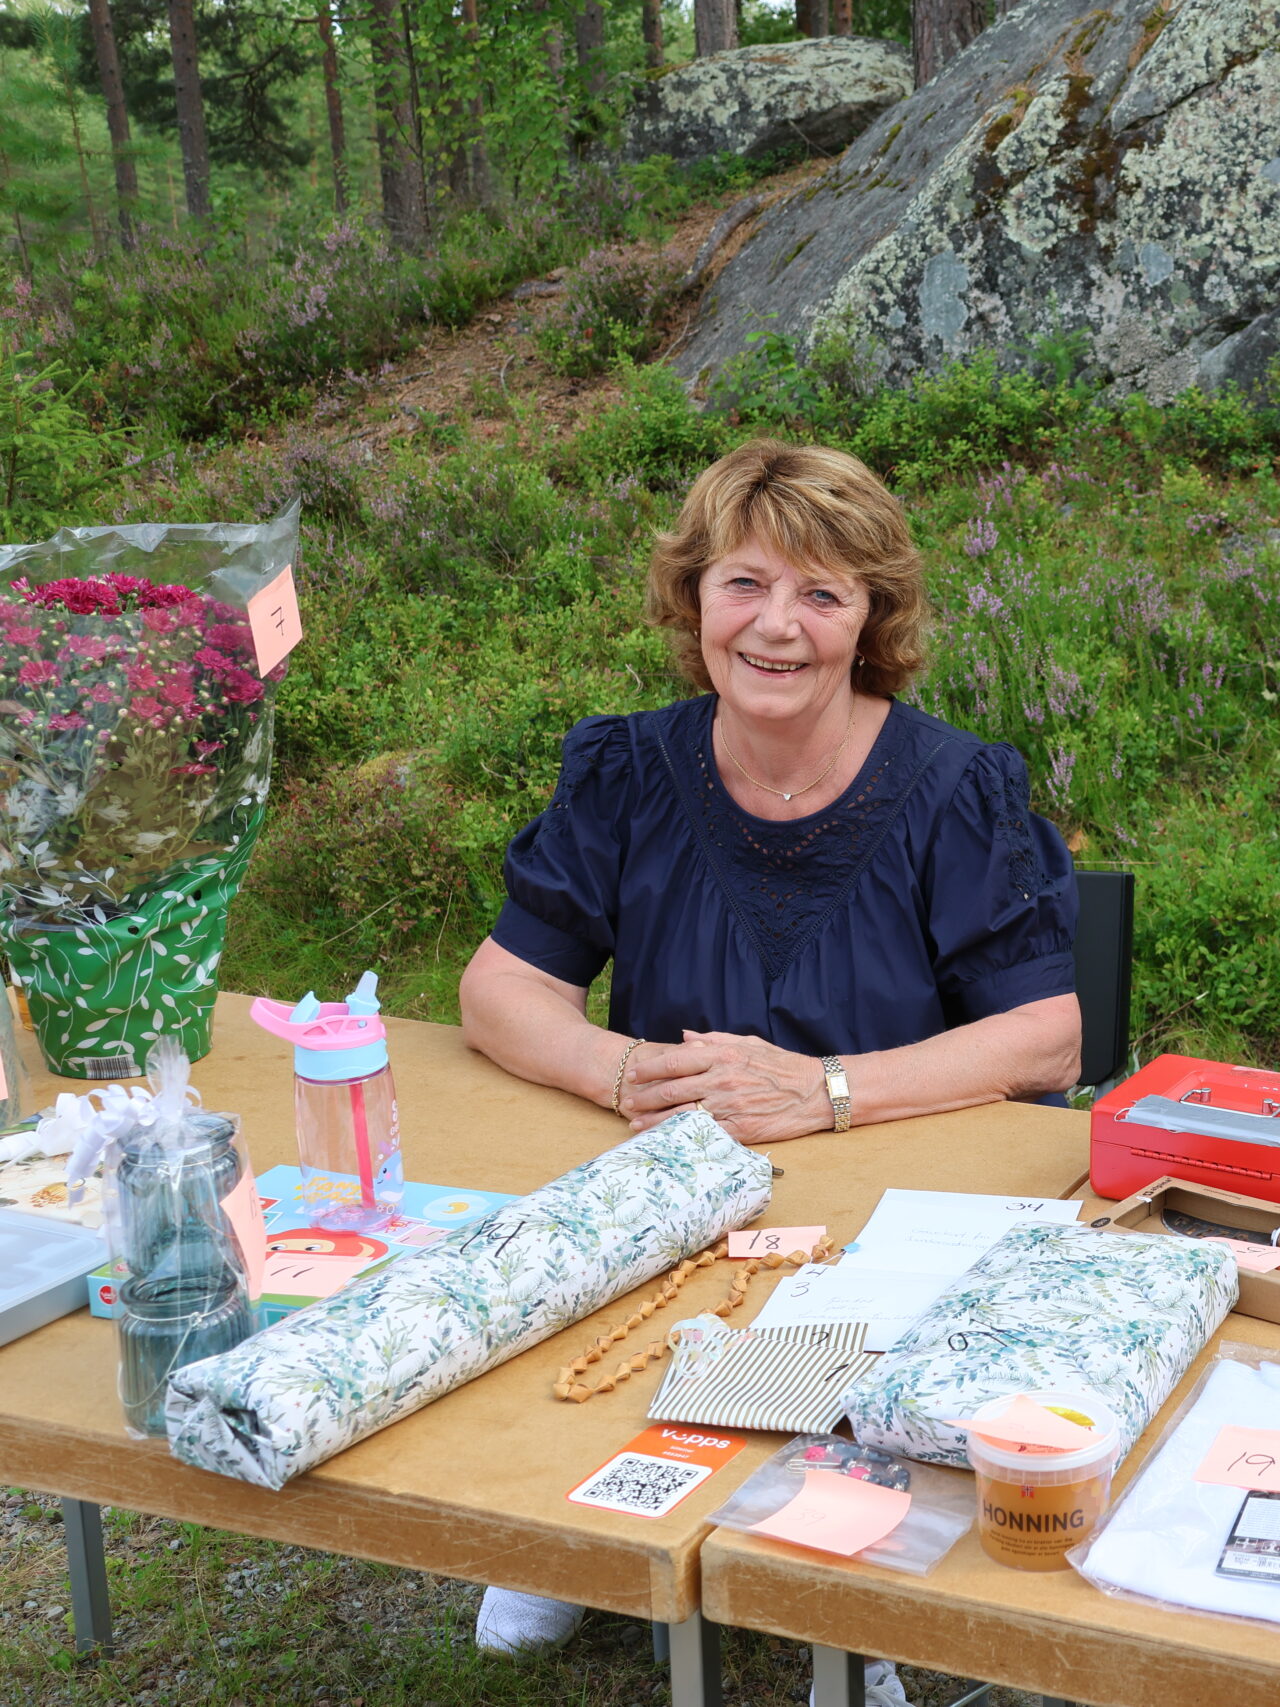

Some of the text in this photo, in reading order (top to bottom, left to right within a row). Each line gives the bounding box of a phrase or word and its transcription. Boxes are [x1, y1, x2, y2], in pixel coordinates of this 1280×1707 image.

[270, 605, 285, 637] 7
[1005, 1202, 1044, 1212] 34
[748, 1230, 781, 1250] 18
[805, 1266, 829, 1278] 4
[790, 1281, 811, 1298] 3
[1227, 1451, 1276, 1477] 19
[983, 1499, 1084, 1533] HONNING
